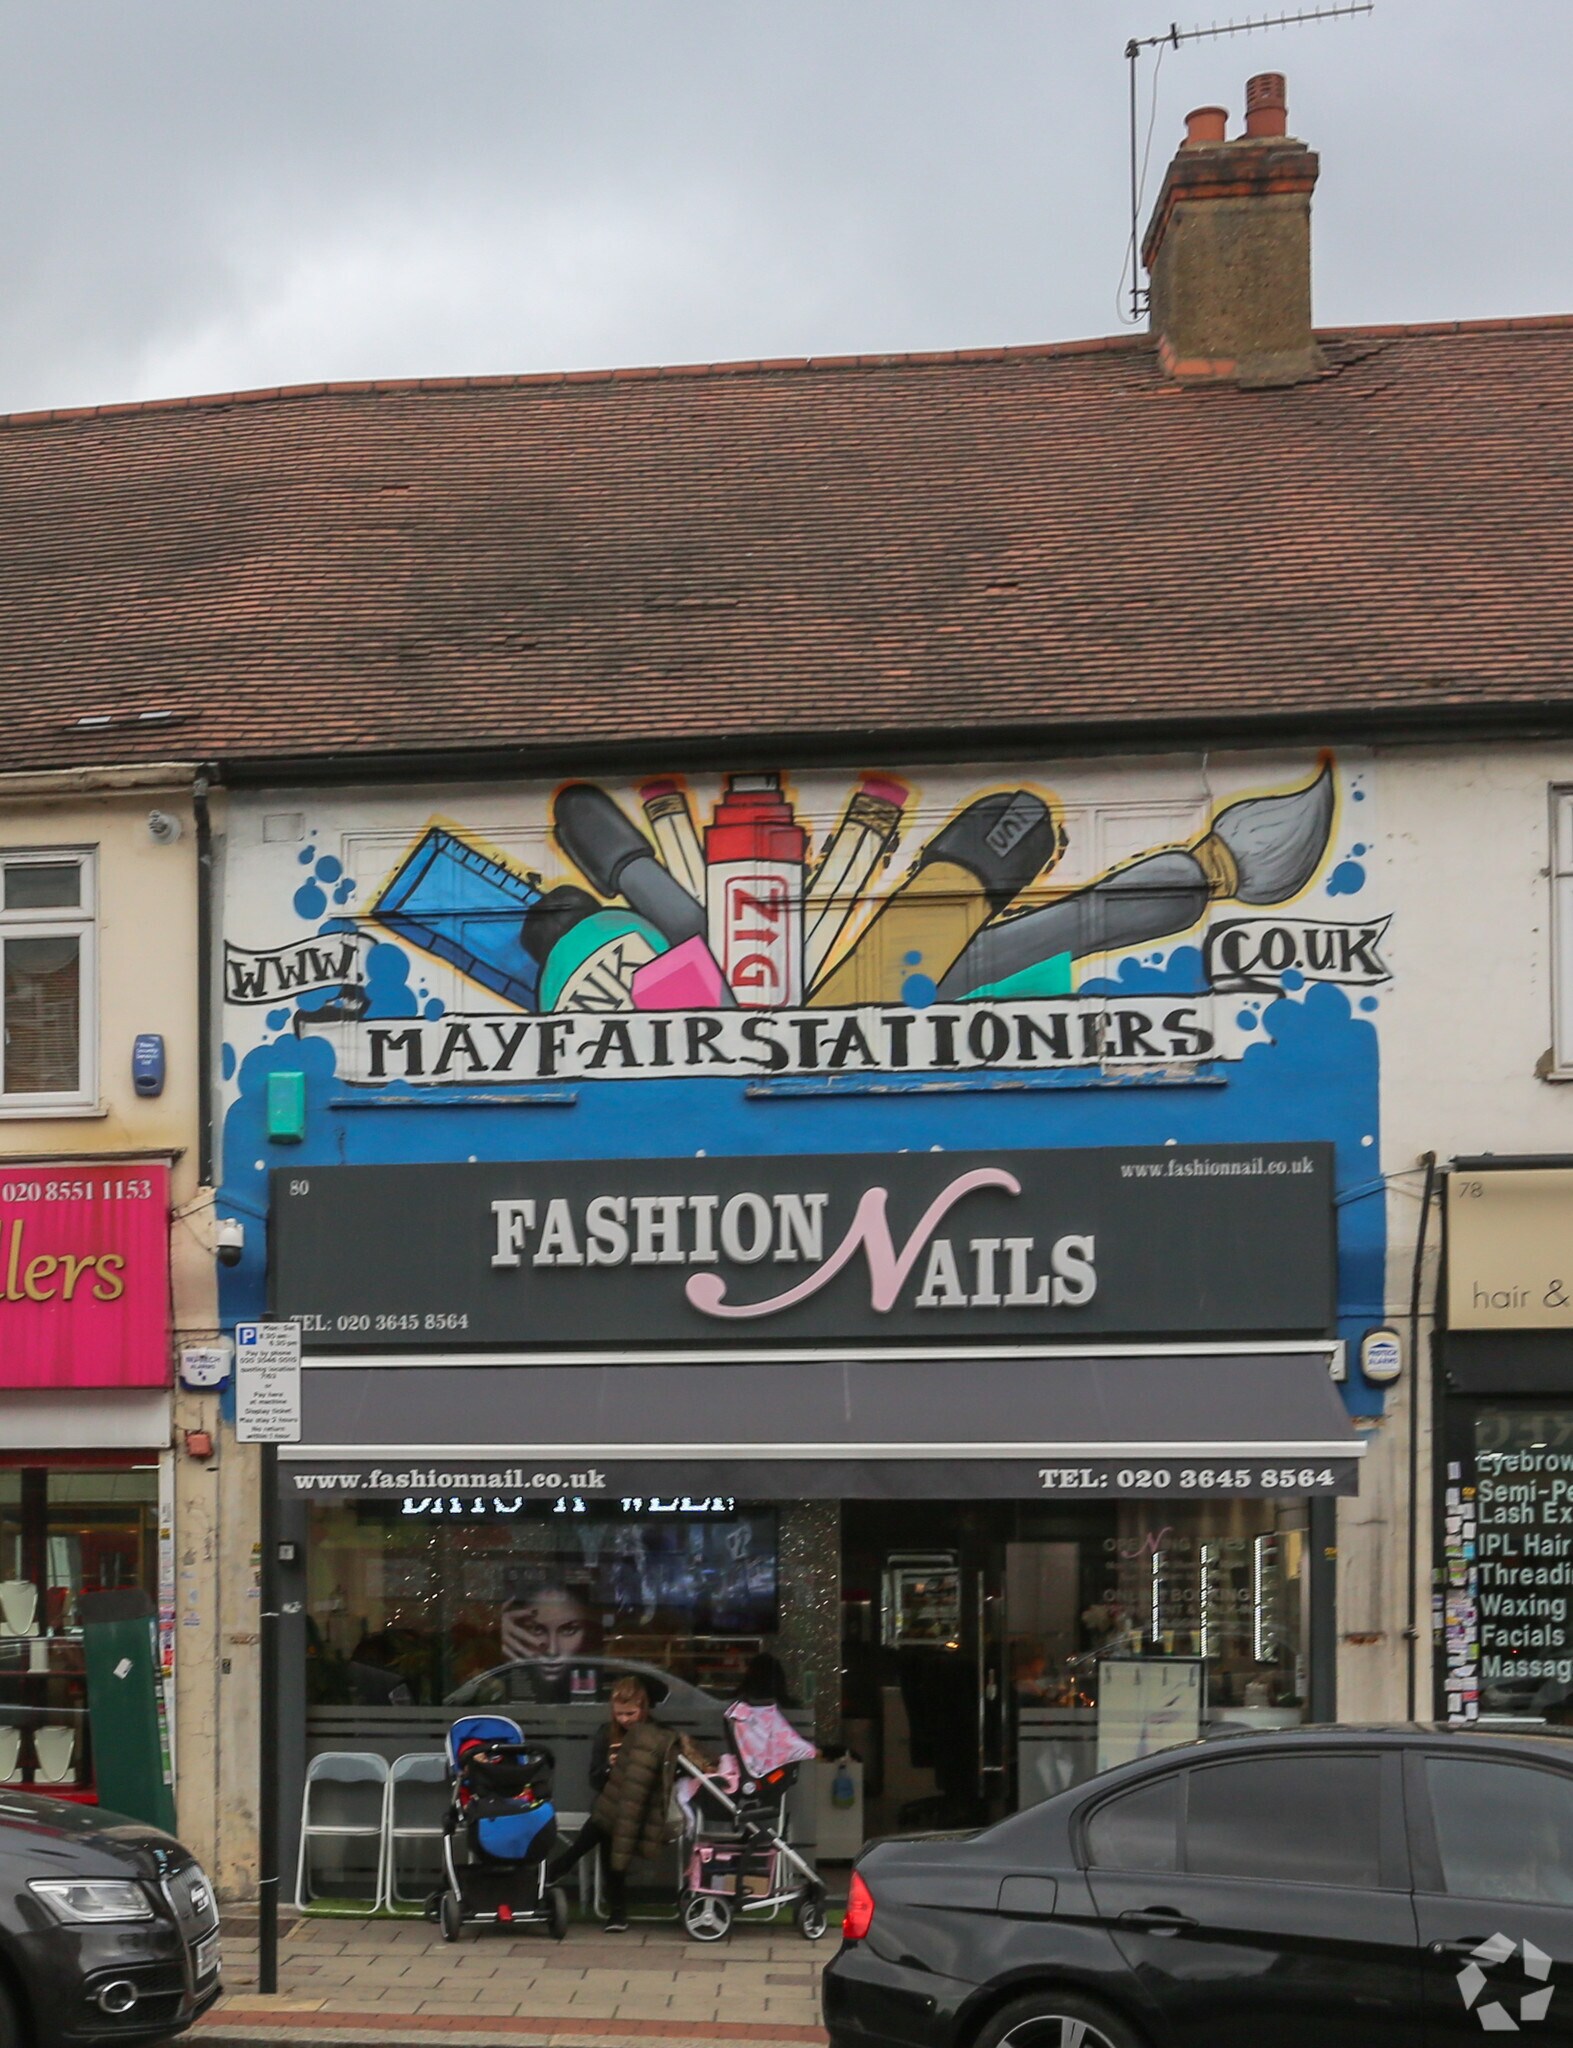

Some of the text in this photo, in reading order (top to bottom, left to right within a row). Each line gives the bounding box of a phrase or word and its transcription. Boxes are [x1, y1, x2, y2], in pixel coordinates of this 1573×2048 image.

[1221, 927, 1386, 976] CO.UK
[564, 943, 640, 1011] NK
[367, 1006, 1215, 1078] MAYFAIRSTATIONERS
[1121, 1155, 1315, 1180] www.fashionnail.co.uk
[2, 1179, 152, 1203] 020 8551 1153
[289, 1180, 310, 1197] 80
[1459, 1181, 1485, 1199] 78
[490, 1165, 1098, 1320] FASHION NAILS
[0, 1218, 126, 1303] lers
[1473, 1279, 1571, 1310] hair &
[337, 1314, 371, 1332] 020
[376, 1313, 419, 1331] 3645
[424, 1313, 469, 1330] 8564
[294, 1468, 607, 1491] www.fashionnail.co.uk
[1039, 1467, 1335, 1490] TEL: 020 3645 8564
[1478, 1501, 1535, 1524] Lash
[1478, 1532, 1572, 1557] IPL Hair
[1478, 1561, 1573, 1586] Threadi
[1480, 1593, 1567, 1622] Waxing
[1481, 1623, 1566, 1647] Facials
[1481, 1654, 1573, 1684] Massag
